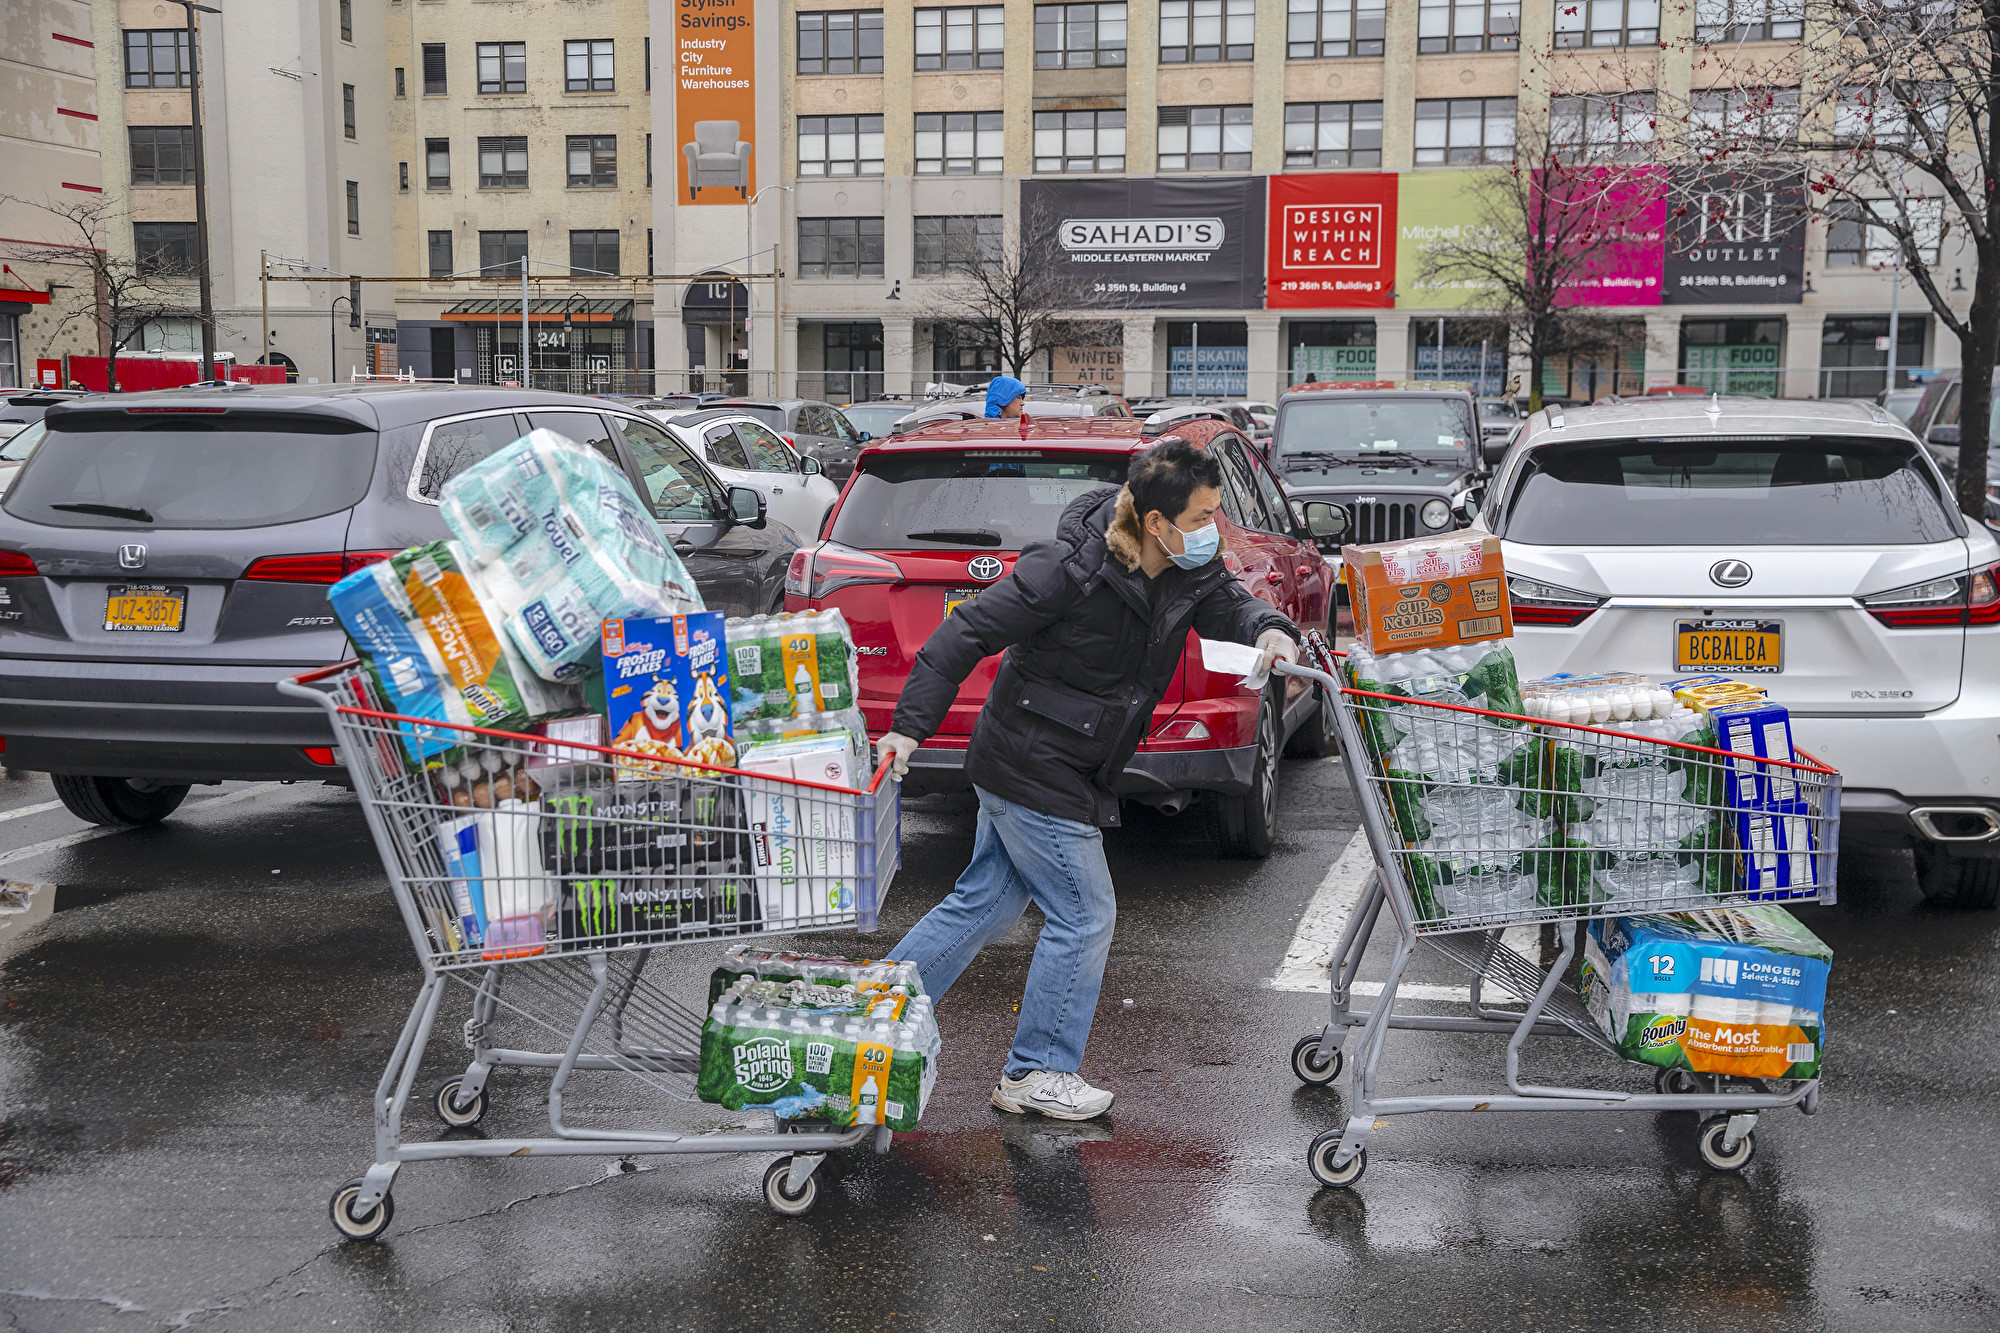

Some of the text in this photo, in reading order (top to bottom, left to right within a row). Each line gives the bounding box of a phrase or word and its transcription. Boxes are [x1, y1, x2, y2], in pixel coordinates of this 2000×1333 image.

[681, 12, 750, 30] Savings.
[681, 38, 726, 50] Industry
[681, 52, 703, 64] City
[681, 65, 732, 76] Furniture
[681, 79, 750, 89] Warehouses
[1294, 210, 1372, 224] DESIGN
[1071, 224, 1212, 244] SAHADI'S
[1293, 230, 1371, 243] WITHIN
[1402, 224, 1459, 239] Mitchell
[1071, 253, 1211, 263] MIDDLE EASTERN MARKET
[1293, 248, 1370, 262] REACH
[1689, 248, 1780, 261] OUTLET
[1281, 281, 1298, 291] 219
[1299, 281, 1320, 291] 36th
[1335, 281, 1373, 292] Building
[1374, 281, 1381, 290] 3
[1602, 277, 1643, 288] Building
[1680, 275, 1694, 287] 34
[1695, 275, 1719, 286] 34th
[1735, 275, 1778, 287] Building
[1778, 274, 1787, 285] 6
[1094, 283, 1106, 292] 34
[1107, 283, 1128, 292] 35th
[1142, 283, 1178, 293] Building
[1178, 283, 1187, 292] 4
[538, 332, 565, 347] 241
[1173, 350, 1248, 362] ICE SKATIN
[1418, 350, 1438, 362] ICE
[1731, 349, 1775, 363] FOOD
[1078, 368, 1114, 381] AT IC
[1173, 378, 1248, 390] ICE SKATIN
[1355, 495, 1376, 504] Jeep
[541, 506, 582, 566] Towel
[1416, 563, 1450, 575] NOODLES
[1423, 557, 1443, 567] CUP
[1474, 589, 1485, 597] 24
[112, 599, 177, 621] JCZ 3857
[1395, 599, 1429, 616] CUP
[286, 616, 334, 627] AWD
[1384, 609, 1443, 631] NOODLES
[1702, 620, 1757, 628] LEXUS
[532, 604, 546, 623] 12
[541, 624, 564, 652] 160
[1391, 630, 1423, 640] CHICKEN
[429, 612, 475, 683] The Most
[688, 638, 716, 659] FROSTED
[789, 638, 810, 652] 40
[1690, 635, 1767, 661] BCBALBA
[616, 648, 666, 669] FROSTED
[691, 650, 715, 670] FLAKES
[738, 647, 759, 659] 100%
[620, 660, 662, 679] FLAKES
[1851, 690, 1913, 699] RX 350
[464, 683, 512, 722] Bounty
[597, 800, 683, 818] MONSTER
[620, 887, 705, 904] MONSTER
[633, 903, 692, 912] ENERGY
[1648, 955, 1675, 976] 12
[1742, 962, 1802, 977] LONGER
[1741, 971, 1801, 987] Select-A-Size
[1640, 1018, 1687, 1047] Bounty
[1688, 1027, 1761, 1045] The Most
[808, 1044, 832, 1056] 100%
[1648, 1037, 1677, 1049] ADVANCED
[1687, 1039, 1732, 1053] Absorbent
[1734, 1045, 1749, 1053] and
[732, 1040, 791, 1068] Poland
[864, 1047, 886, 1064] 40
[734, 1058, 793, 1085] Spring
